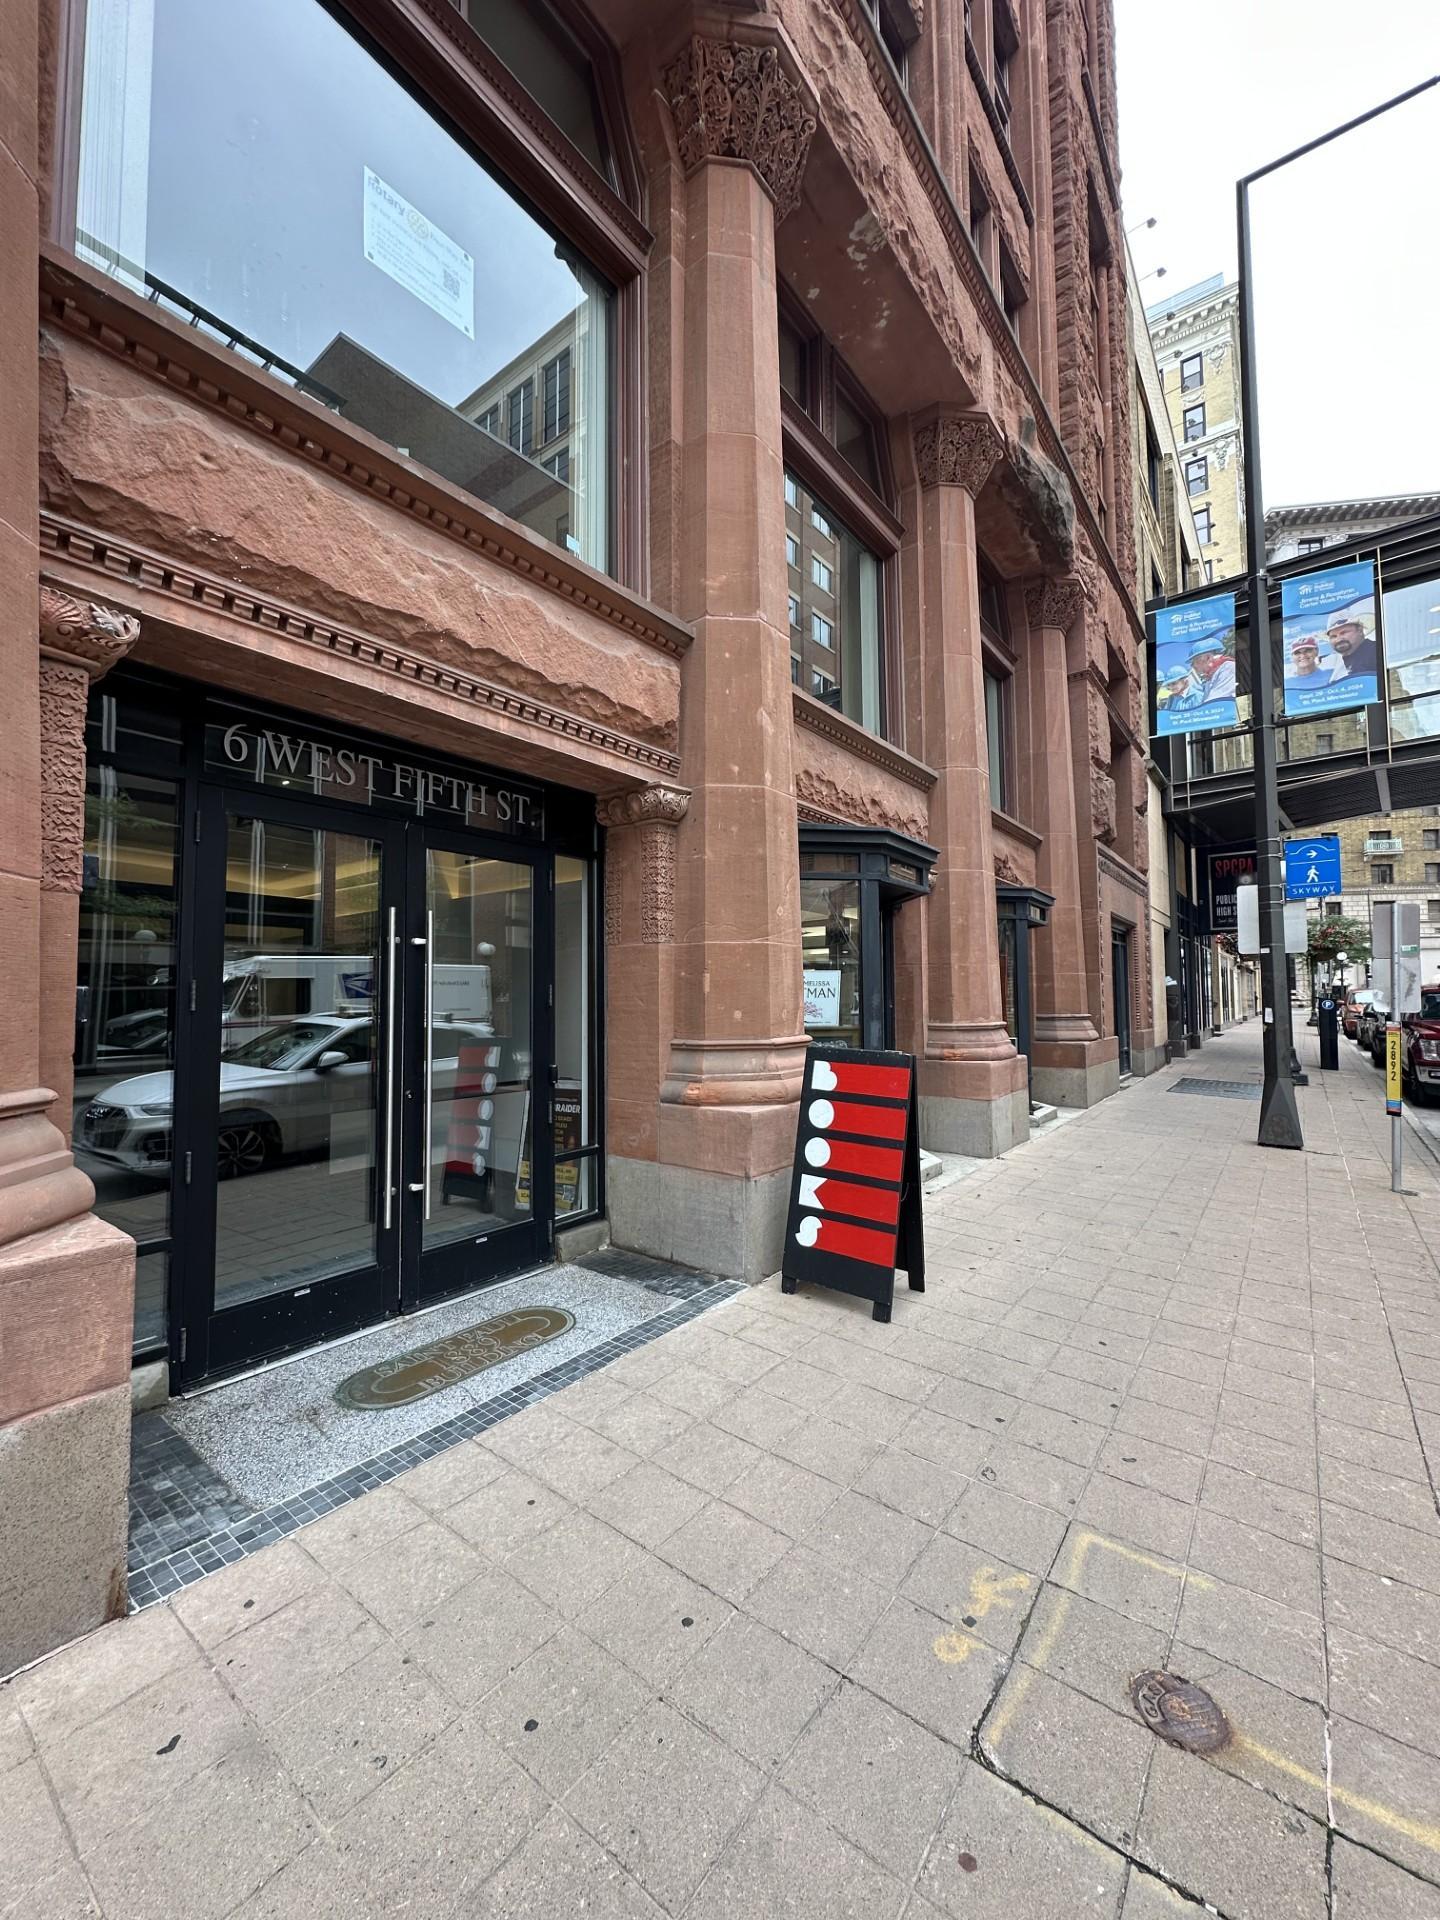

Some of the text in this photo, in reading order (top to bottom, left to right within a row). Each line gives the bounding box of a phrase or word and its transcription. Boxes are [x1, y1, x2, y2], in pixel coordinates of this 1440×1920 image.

[367, 175, 406, 217] Rotary
[223, 724, 536, 827] 6 WEST FIFTH ST.
[1215, 857, 1254, 878] SPCPA
[1292, 885, 1335, 895] SKYWAY
[1216, 906, 1230, 916] HIGH
[804, 987, 836, 999] MAN
[555, 1103, 581, 1114] RAIDER
[373, 1314, 528, 1379] SAINT PAUL
[428, 1337, 501, 1370] 1889
[415, 1331, 545, 1392] BUILDING
